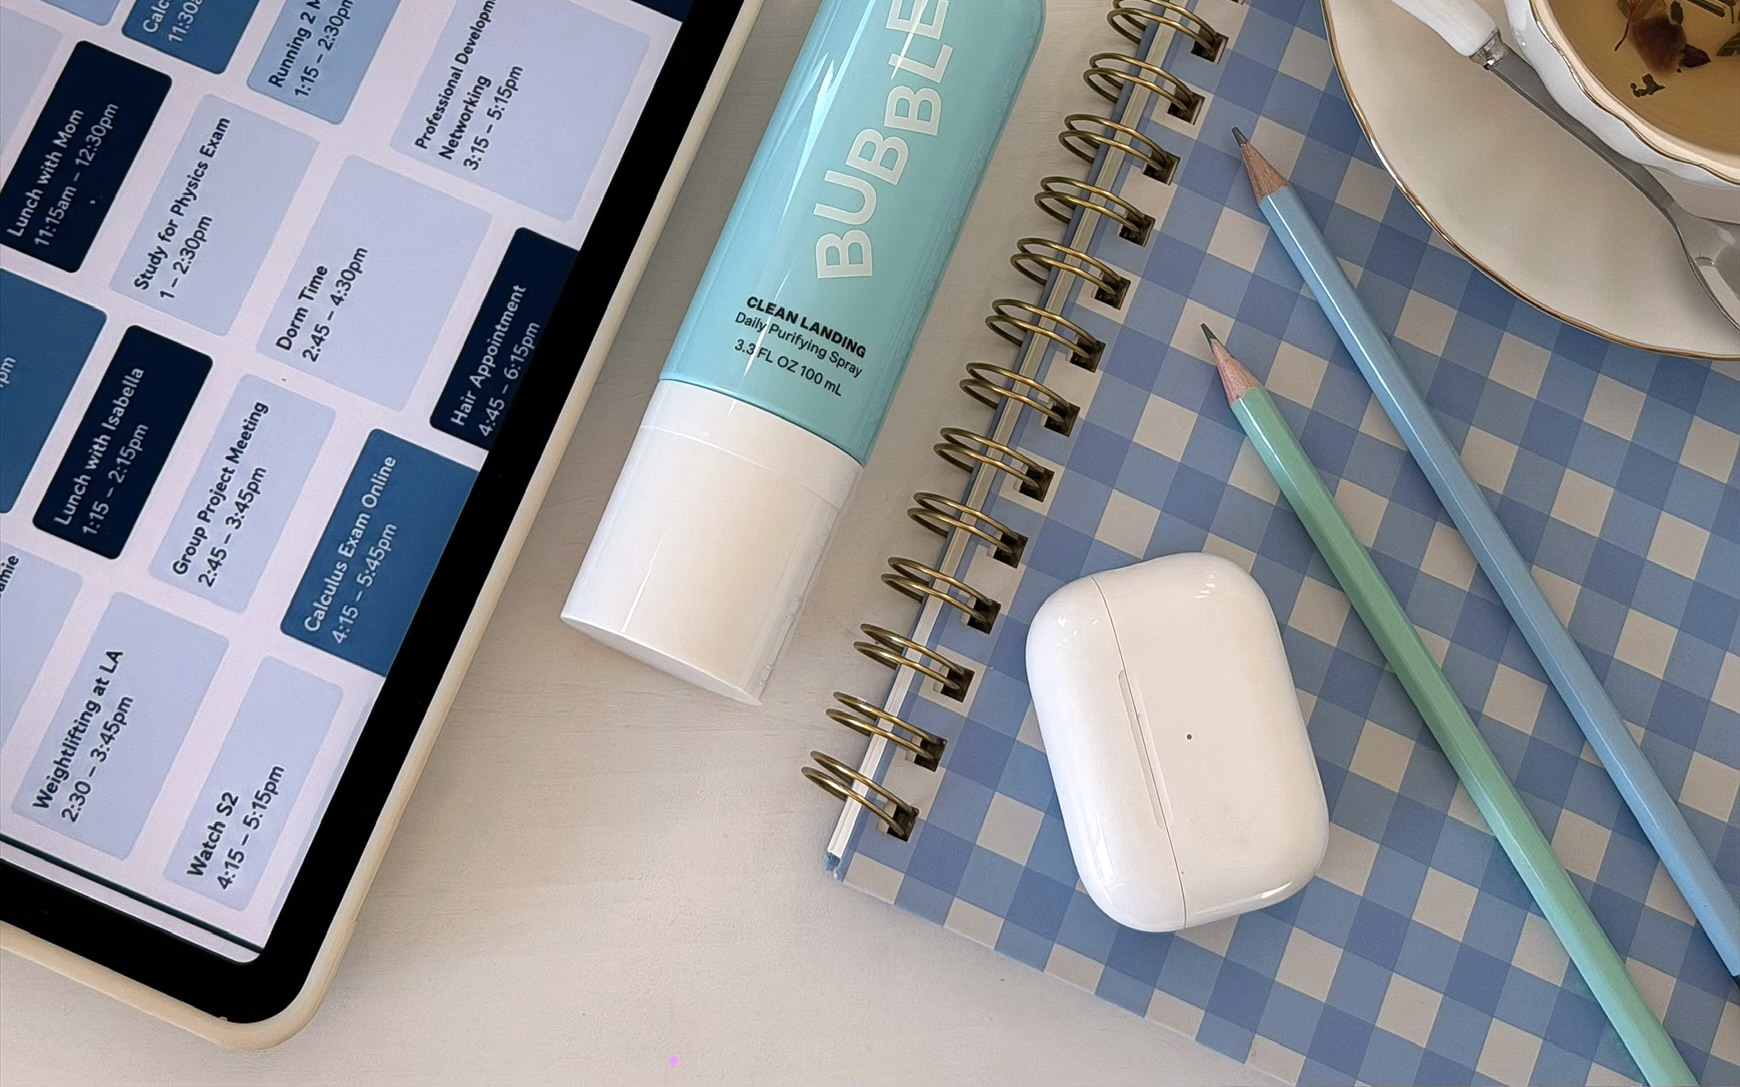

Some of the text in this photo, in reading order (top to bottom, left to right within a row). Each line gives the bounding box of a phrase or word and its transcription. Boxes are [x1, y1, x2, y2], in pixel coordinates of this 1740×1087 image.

[268, 27, 312, 88] Running
[300, 11, 317, 25] 2
[294, 65, 319, 96] 1:15
[414, 66, 464, 150] Professional
[438, 75, 492, 160] Networking
[463, 135, 490, 171] 3:15
[486, 66, 523, 121] 5:15pm
[6, 109, 84, 237] Lunch with Mom
[34, 186, 77, 246] 11:15am
[75, 103, 119, 166] 12:30pm
[133, 117, 231, 290] Study for Physics Exam
[159, 290, 175, 299] 1
[172, 216, 213, 275] 2:30pm
[275, 265, 328, 351] Dorm Time
[302, 323, 330, 363] 2:45
[329, 247, 368, 306] 4:30pm
[450, 285, 526, 426] Hair Appointment
[478, 397, 505, 437] 4:45
[503, 322, 540, 380] 6:15pm
[734, 338, 842, 397] 3.3 FL OZ 100 mL
[735, 311, 863, 379] Daily Purifying Spray
[746, 296, 867, 359] CLEAN LANDING
[54, 368, 145, 525] Lunch with Isabella
[82, 501, 109, 534] 1:15
[108, 424, 149, 484] 2:15pm
[172, 402, 269, 575] Group Project Meeting
[197, 546, 227, 588] 2:45
[225, 467, 267, 530] 3:45pm
[304, 456, 396, 632] Calculus Exam Online
[332, 605, 359, 644] 4:15
[356, 524, 397, 587] 5:45pm
[32, 651, 124, 809] Weightlifting at LA
[61, 780, 91, 823] 2:30
[89, 696, 134, 763] 3:45pm
[186, 792, 239, 876] Watch S2
[217, 848, 245, 890] 4:15
[242, 766, 285, 830] 5:15pm
